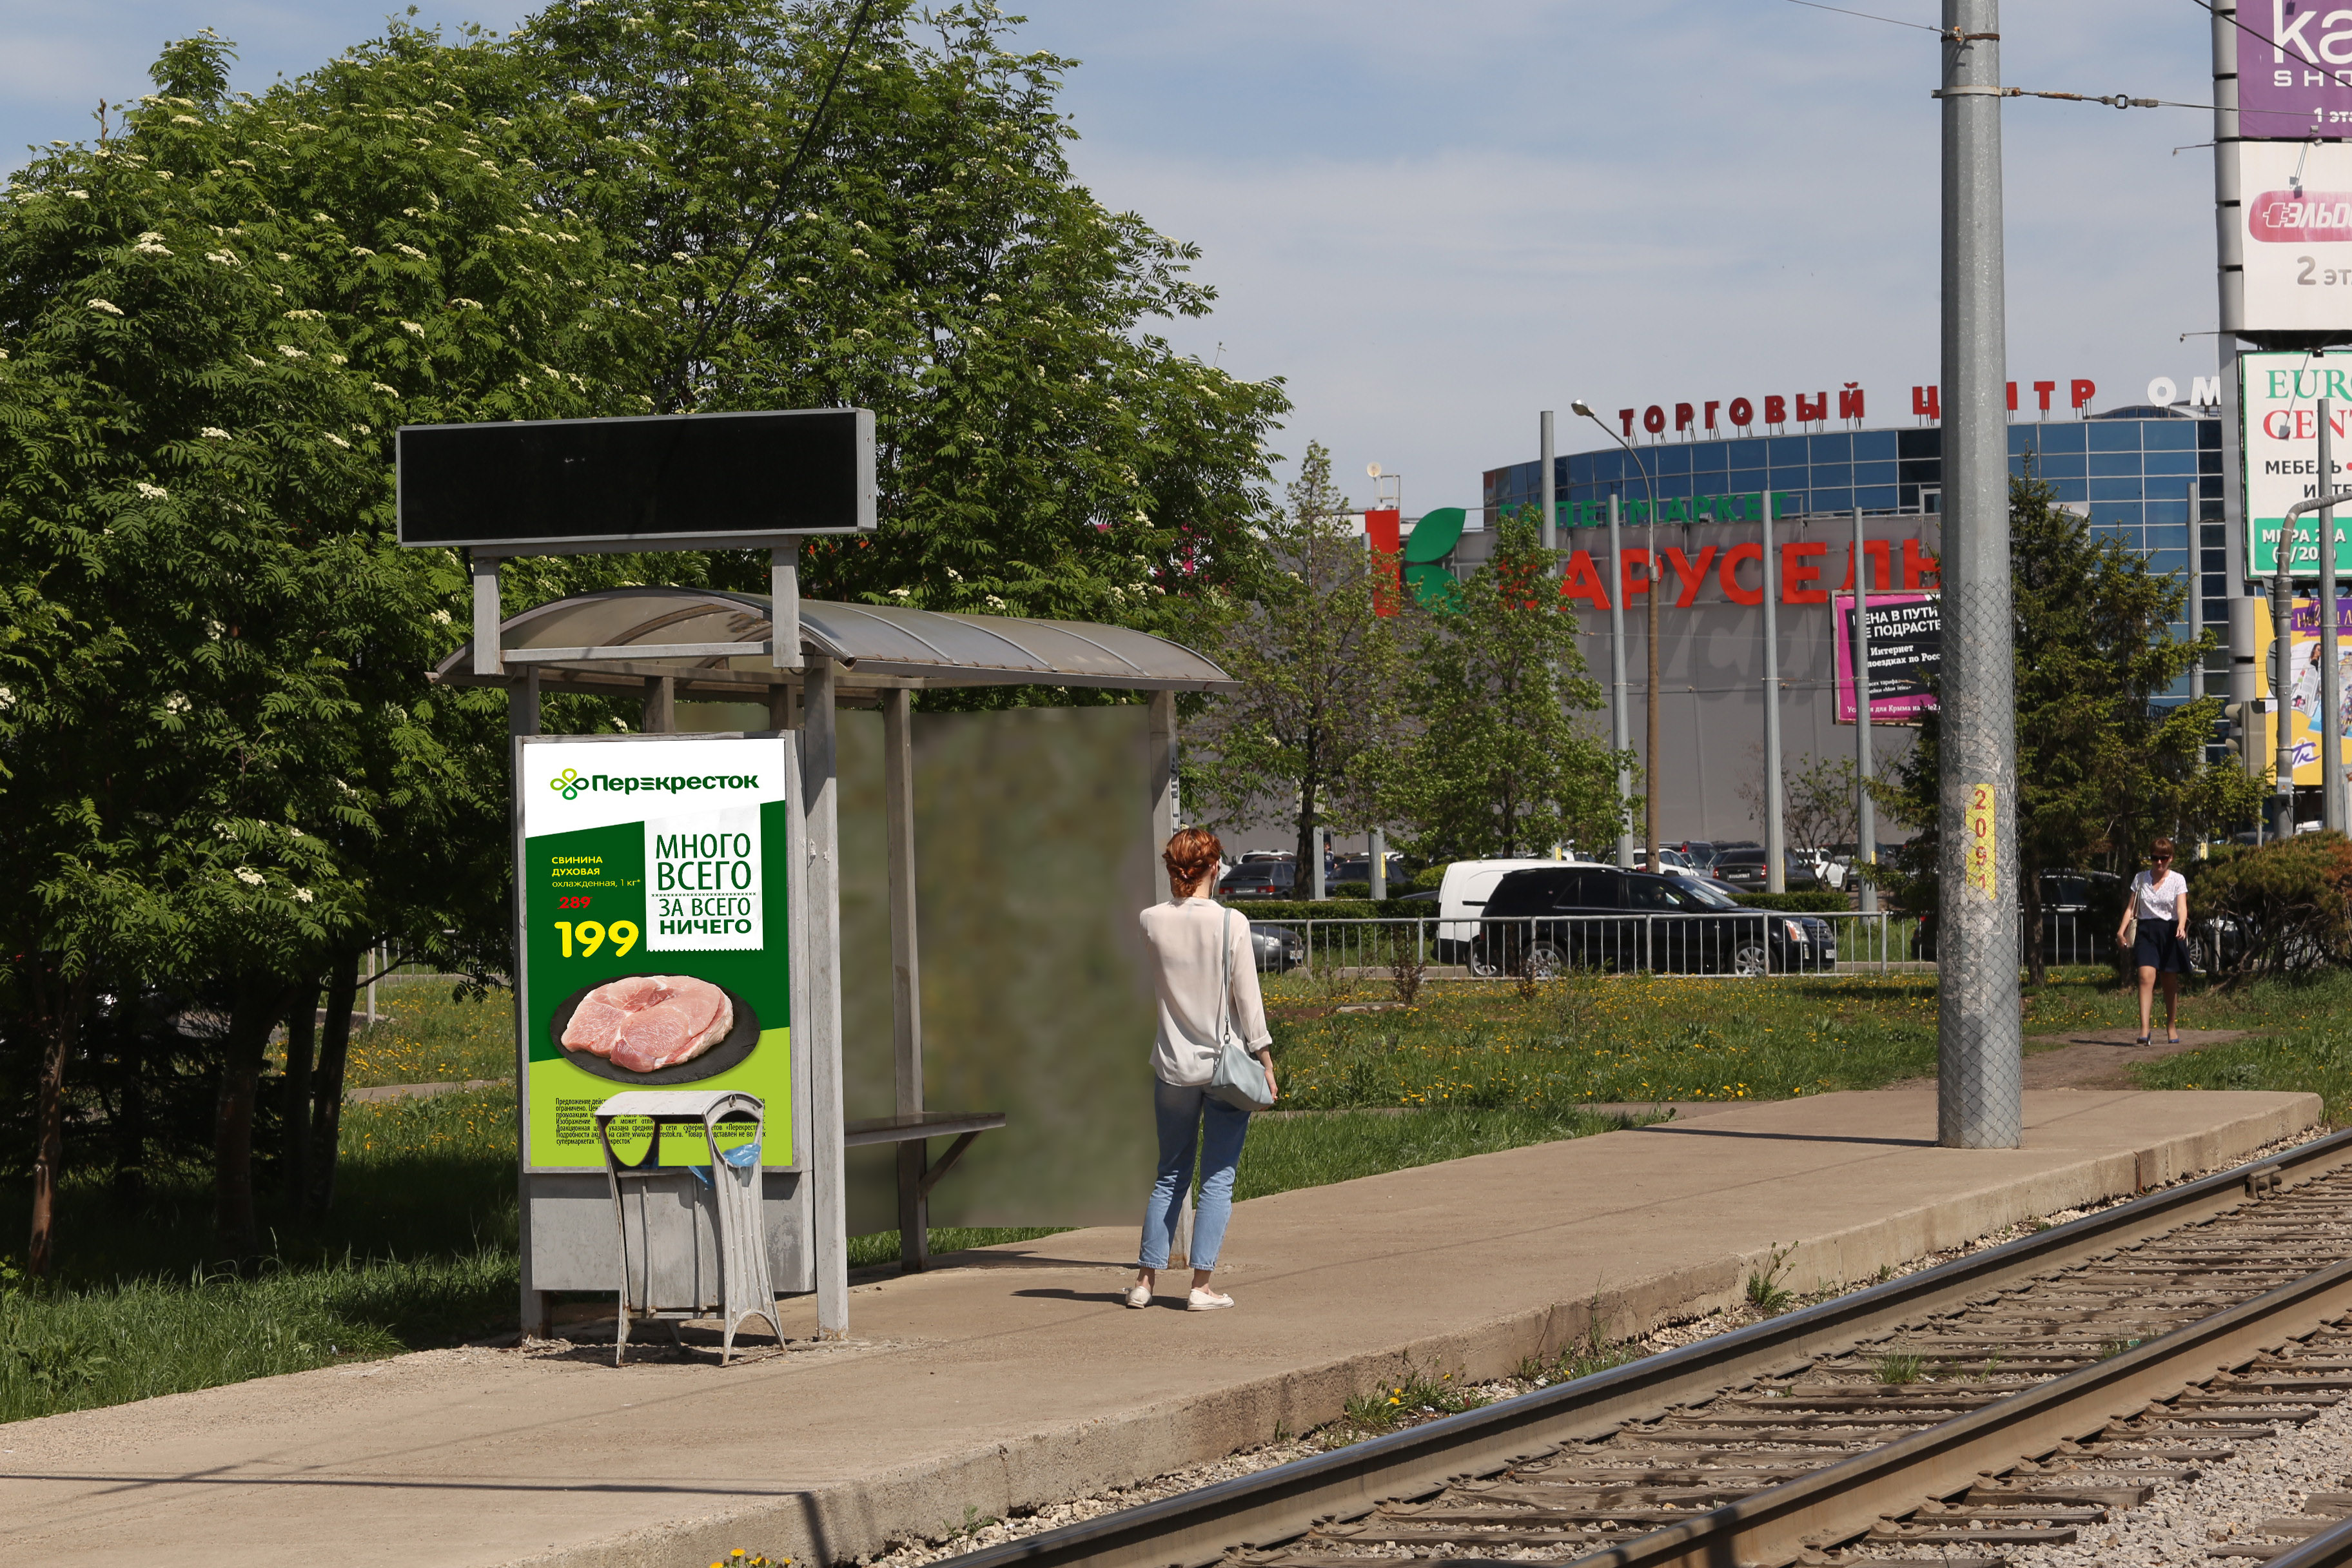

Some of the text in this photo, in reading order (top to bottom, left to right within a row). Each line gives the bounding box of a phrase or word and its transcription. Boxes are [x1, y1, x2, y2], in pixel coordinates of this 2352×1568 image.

[2314, 107, 2322, 122] 1
[2284, 202, 2352, 228] ЭЛЬД
[2297, 256, 2352, 285] 2 эт
[2265, 369, 2352, 402] EUR
[1619, 382, 1865, 437] ТОРГОВЫЙ
[1912, 379, 2095, 420] ЦТР
[2263, 409, 2352, 440] CEN
[2265, 460, 2342, 475] МЕБЕЬ
[1500, 492, 1789, 527] ГПЕМАРКЕТ
[1498, 538, 1940, 611] АРУСЕЛЬ
[1891, 610, 1899, 622] В
[1870, 645, 1914, 656] Интернет
[1908, 655, 1919, 663] по
[1888, 704, 1908, 712] Крыма
[592, 774, 760, 795] Перекресток
[656, 832, 751, 859] МНОГО
[1974, 789, 1987, 889] 2091
[551, 856, 603, 865] СВИНИНА
[551, 868, 601, 877] ДУХОВАЯ
[658, 860, 752, 891] ВСЕГО
[552, 880, 618, 888] охлажденная,
[557, 896, 593, 909] 289
[659, 897, 751, 917] ЗА ВСЕГО
[660, 919, 752, 935] НИЧЕГО
[554, 920, 640, 958] 199
[589, 1104, 600, 1112] Цен
[631, 1130, 683, 1139] www.perestok.ru.
